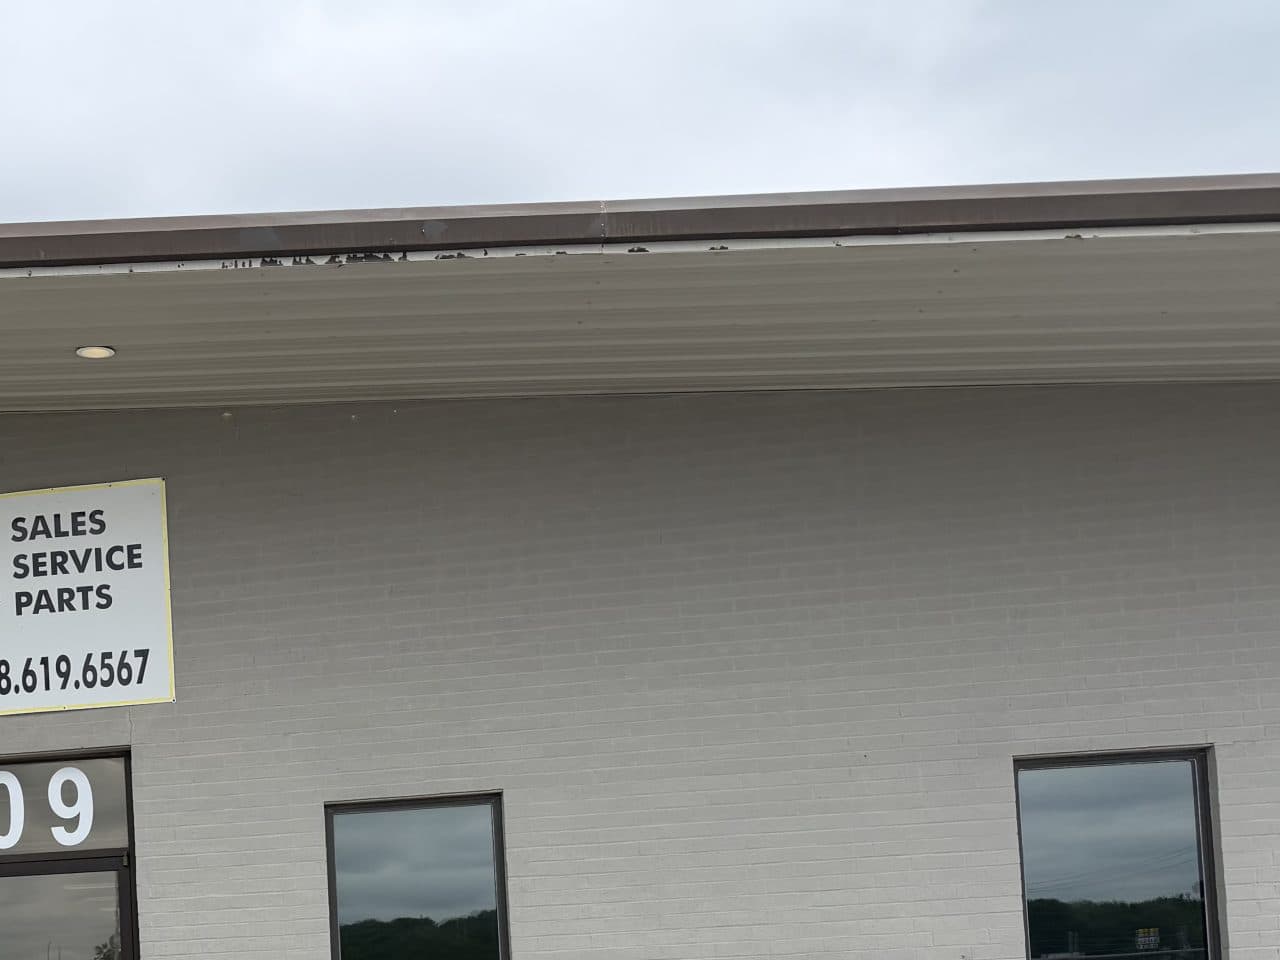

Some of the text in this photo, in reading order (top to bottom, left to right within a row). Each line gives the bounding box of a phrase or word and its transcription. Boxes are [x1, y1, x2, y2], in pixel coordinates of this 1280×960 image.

[11, 509, 106, 542] SALES
[13, 544, 143, 579] SERVICE
[15, 584, 113, 616] PARTS
